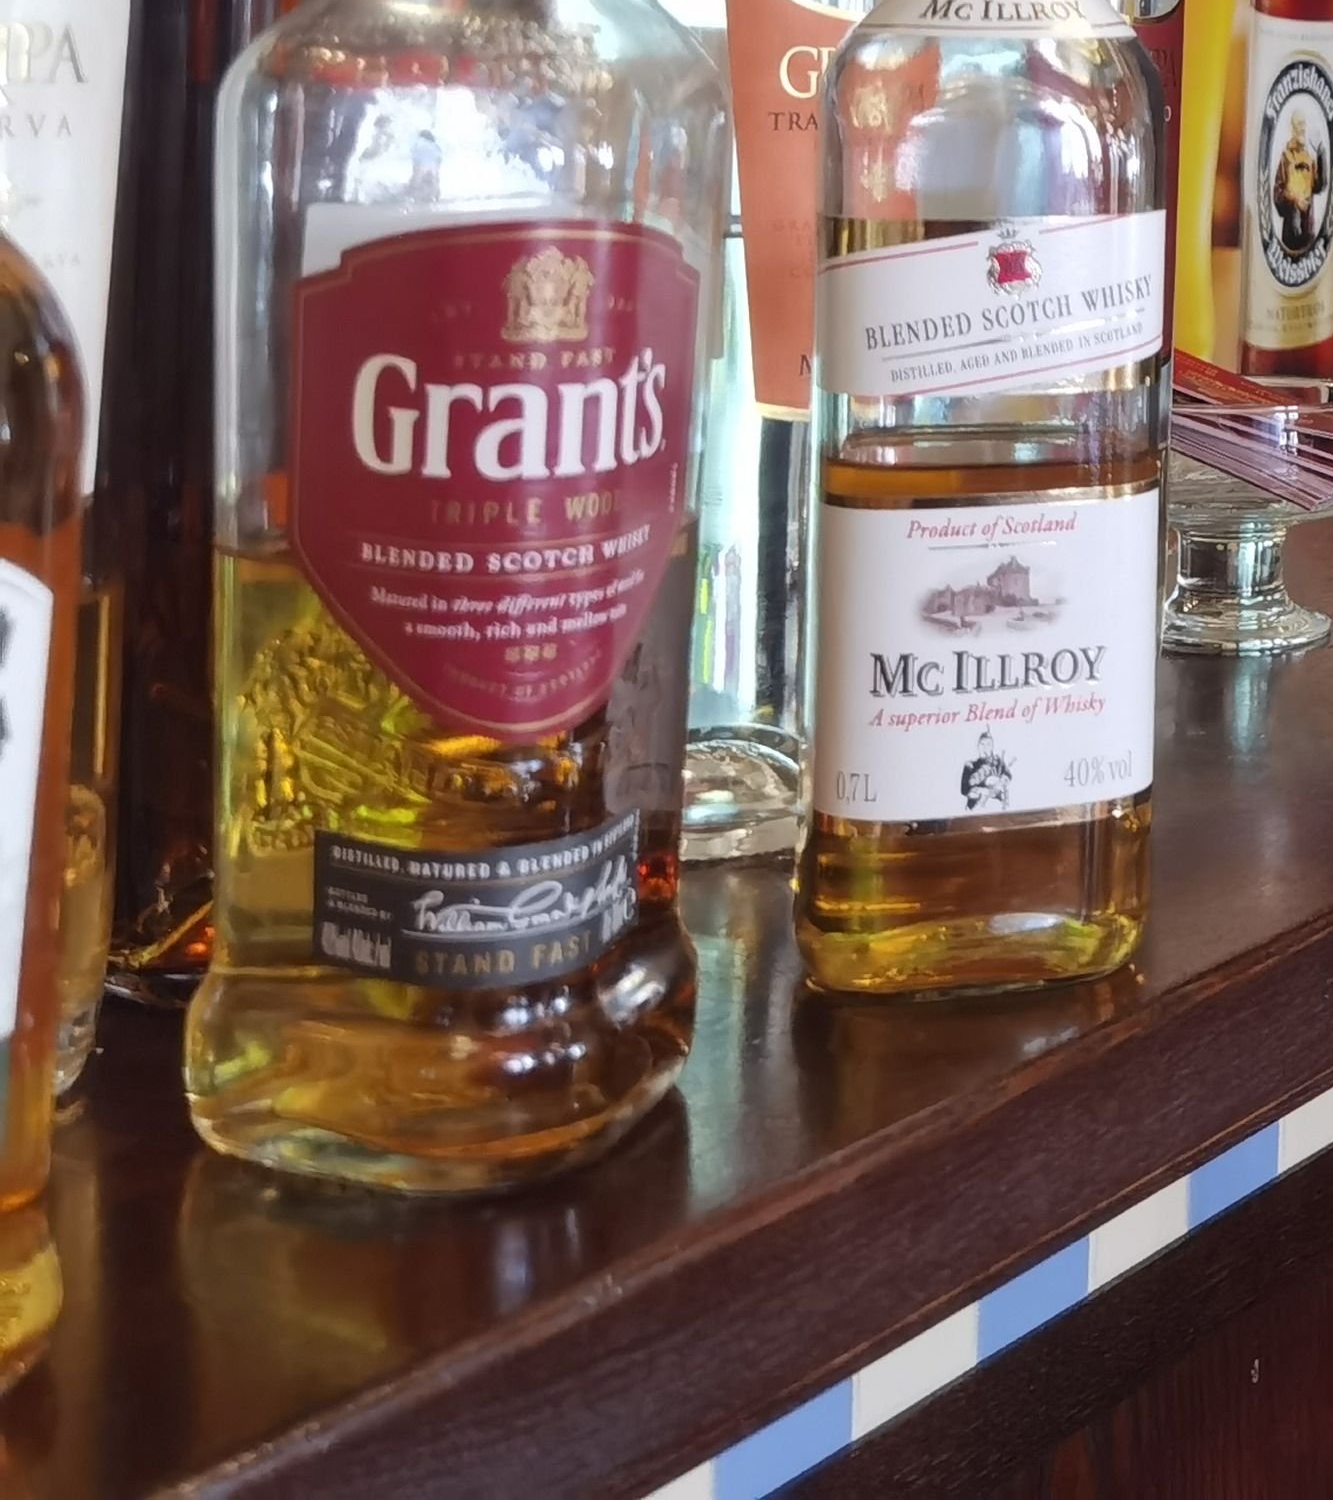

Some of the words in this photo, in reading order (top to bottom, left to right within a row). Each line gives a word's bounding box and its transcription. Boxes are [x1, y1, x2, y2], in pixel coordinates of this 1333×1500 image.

[865, 312, 973, 351] BLENDED
[981, 293, 1073, 332] SCOTCH
[1080, 274, 1153, 312] WHISKY
[960, 357, 991, 373] AGED
[994, 350, 1019, 366] AND
[1021, 338, 1075, 360] BLENDED
[1078, 335, 1091, 348] IN
[1094, 322, 1144, 345] SCOTLAND
[351, 347, 667, 482] Grant's
[906, 518, 977, 540] Product
[981, 515, 1001, 541] of
[1000, 511, 1077, 536] Scotland
[361, 541, 475, 574] BLENDED
[486, 542, 595, 575] SCOTCH
[869, 708, 884, 728] A
[888, 704, 961, 732] superior
[965, 702, 1017, 724] Blend
[1020, 699, 1041, 725] of
[1043, 693, 1108, 718] Whisky
